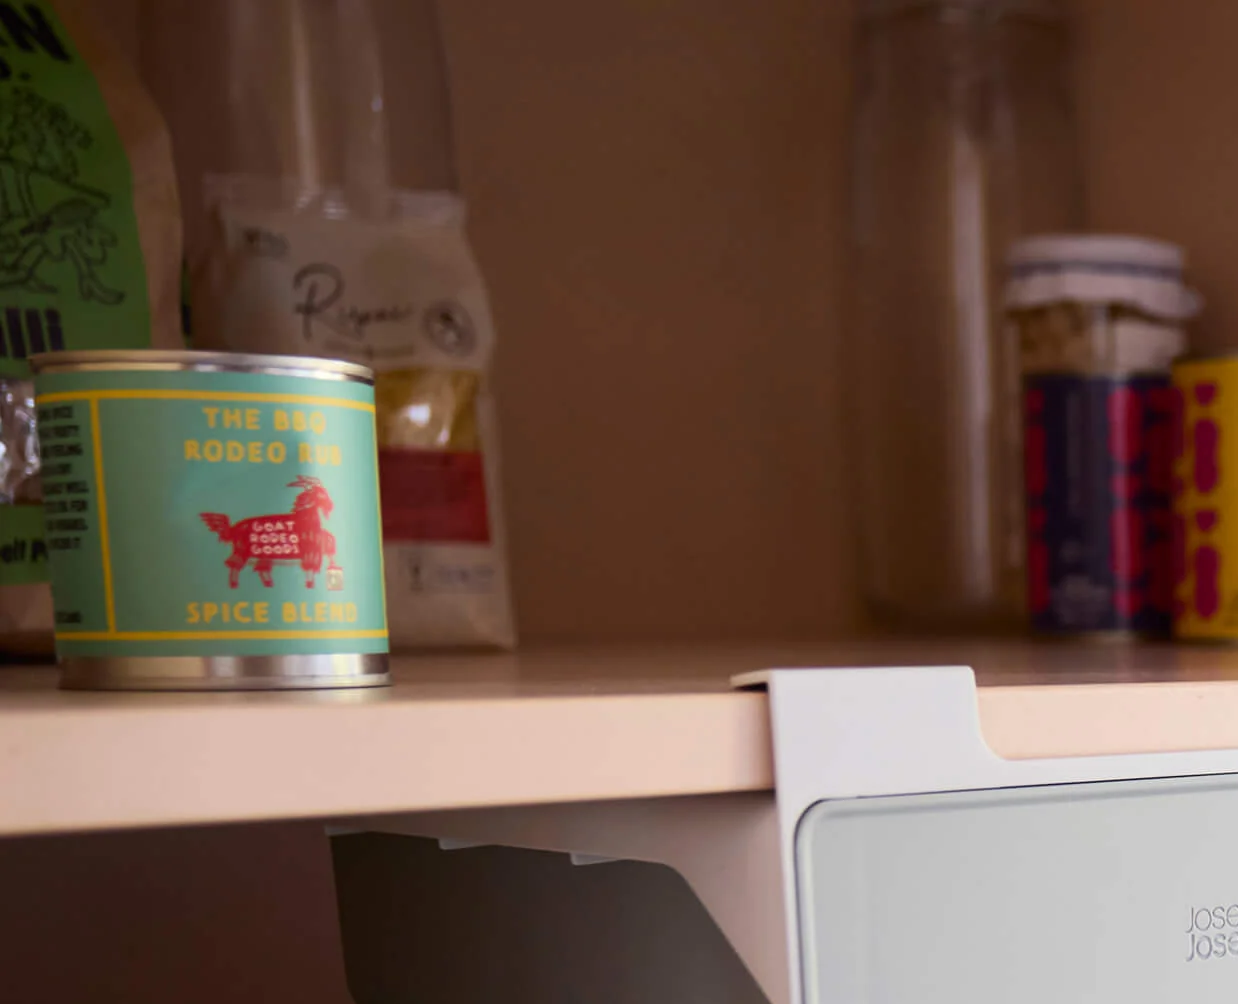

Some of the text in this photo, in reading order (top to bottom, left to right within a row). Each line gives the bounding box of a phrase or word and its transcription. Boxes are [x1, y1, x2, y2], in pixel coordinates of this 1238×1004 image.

[203, 407, 326, 435] THE BBQ
[184, 440, 342, 466] RODEO RUB
[252, 521, 295, 532] GOAT
[249, 533, 299, 544] RODEO
[250, 544, 299, 555] GOODS
[186, 602, 358, 624] SPICE BLEND
